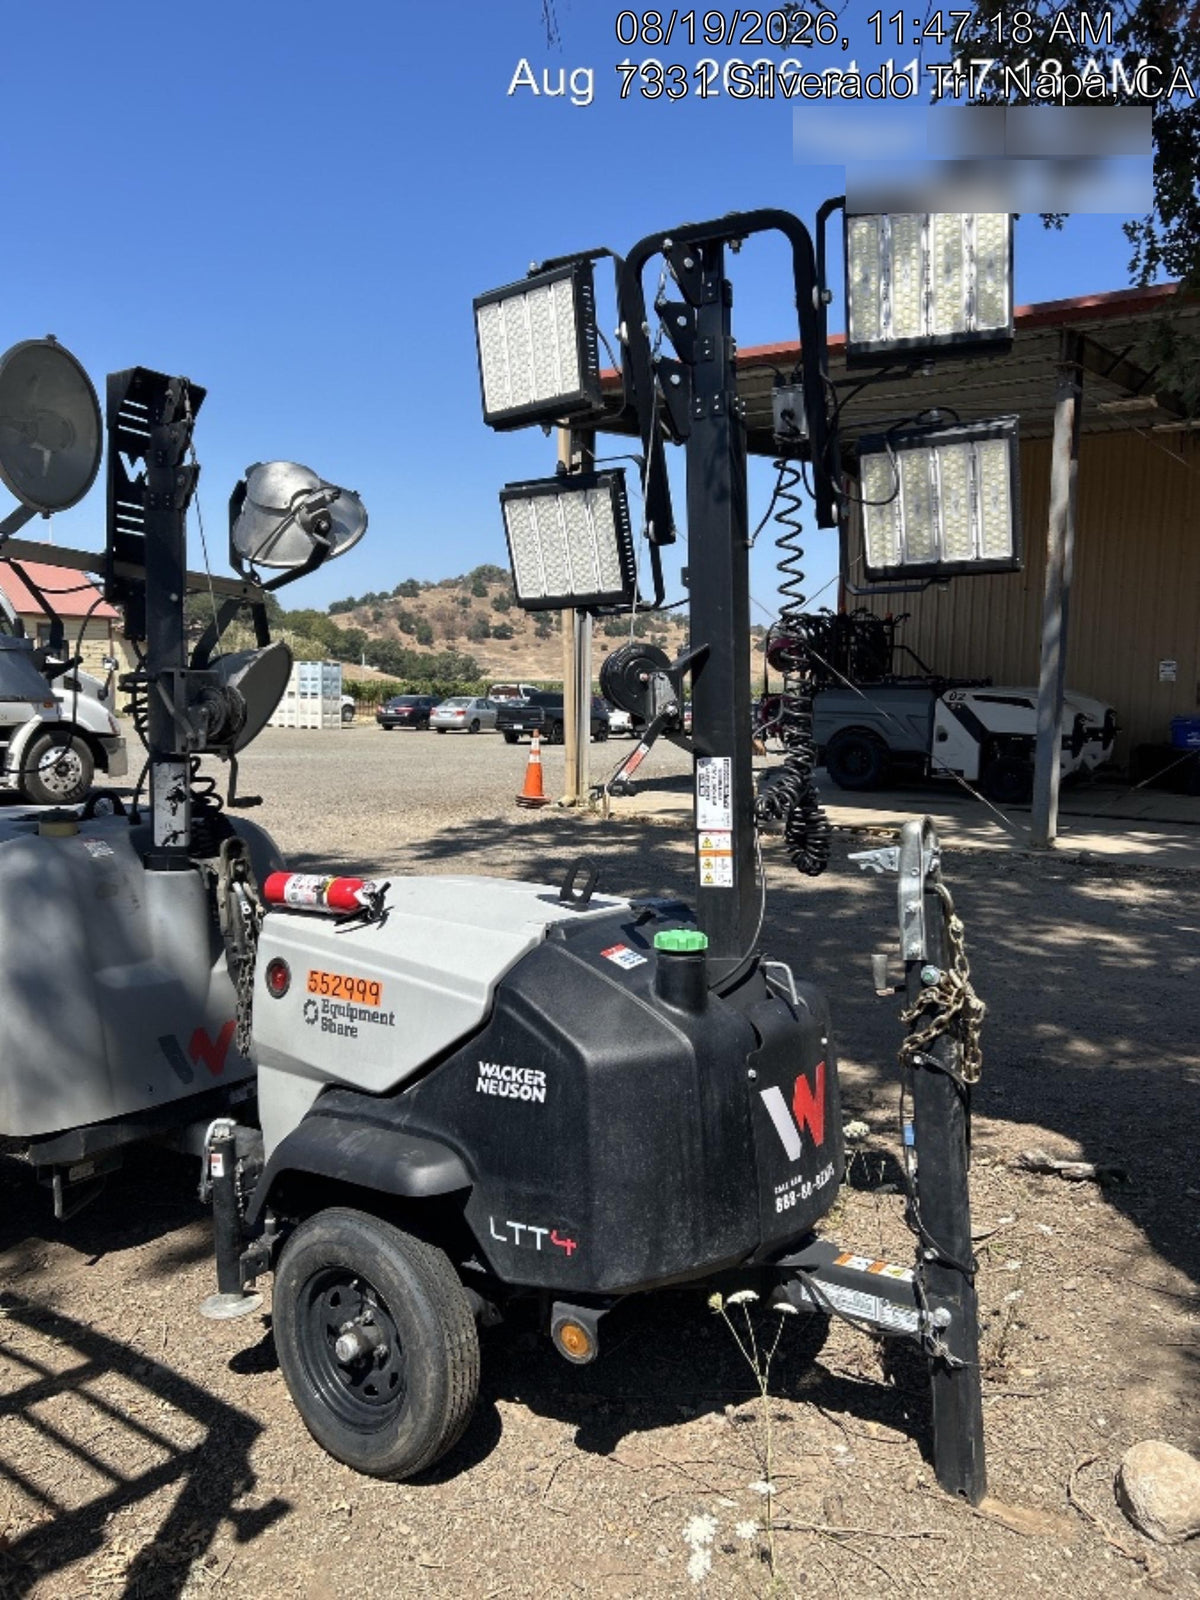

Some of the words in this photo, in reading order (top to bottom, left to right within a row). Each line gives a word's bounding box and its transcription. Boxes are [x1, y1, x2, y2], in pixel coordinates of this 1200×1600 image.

[308, 970, 379, 1005] 552999
[321, 998, 395, 1026] Equipment
[321, 1017, 358, 1038] Share
[478, 1061, 547, 1088] WACKER
[476, 1076, 547, 1103] NEUSON
[489, 1216, 577, 1257] LTT4
